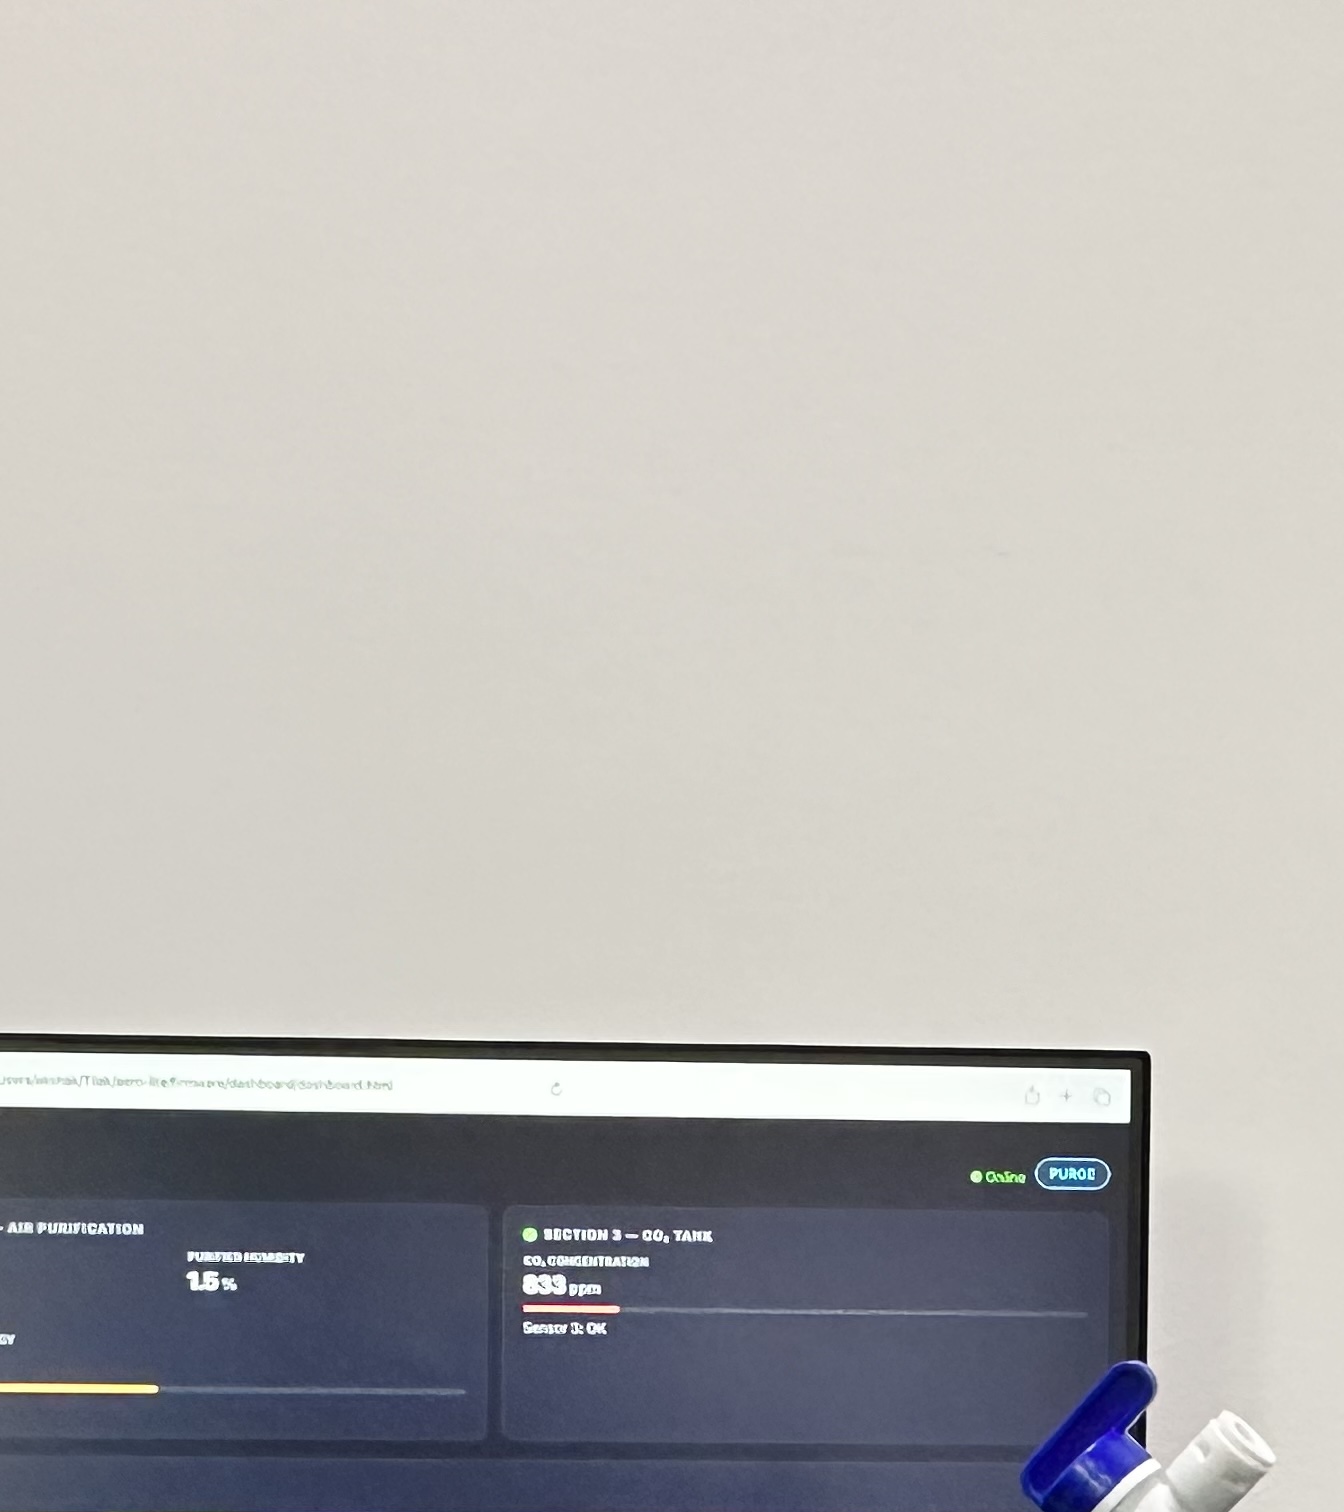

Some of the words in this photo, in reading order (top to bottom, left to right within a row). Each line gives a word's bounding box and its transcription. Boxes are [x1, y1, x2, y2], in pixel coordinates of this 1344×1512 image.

[7, 1222, 34, 1234] AIR
[37, 1222, 145, 1236] PURIFICATION
[543, 1228, 609, 1242] SECTION
[612, 1229, 623, 1242] 3
[673, 1229, 714, 1243] TANK
[522, 1273, 567, 1296] 833
[568, 1283, 602, 1297] ppm
[586, 1322, 608, 1335] OK
